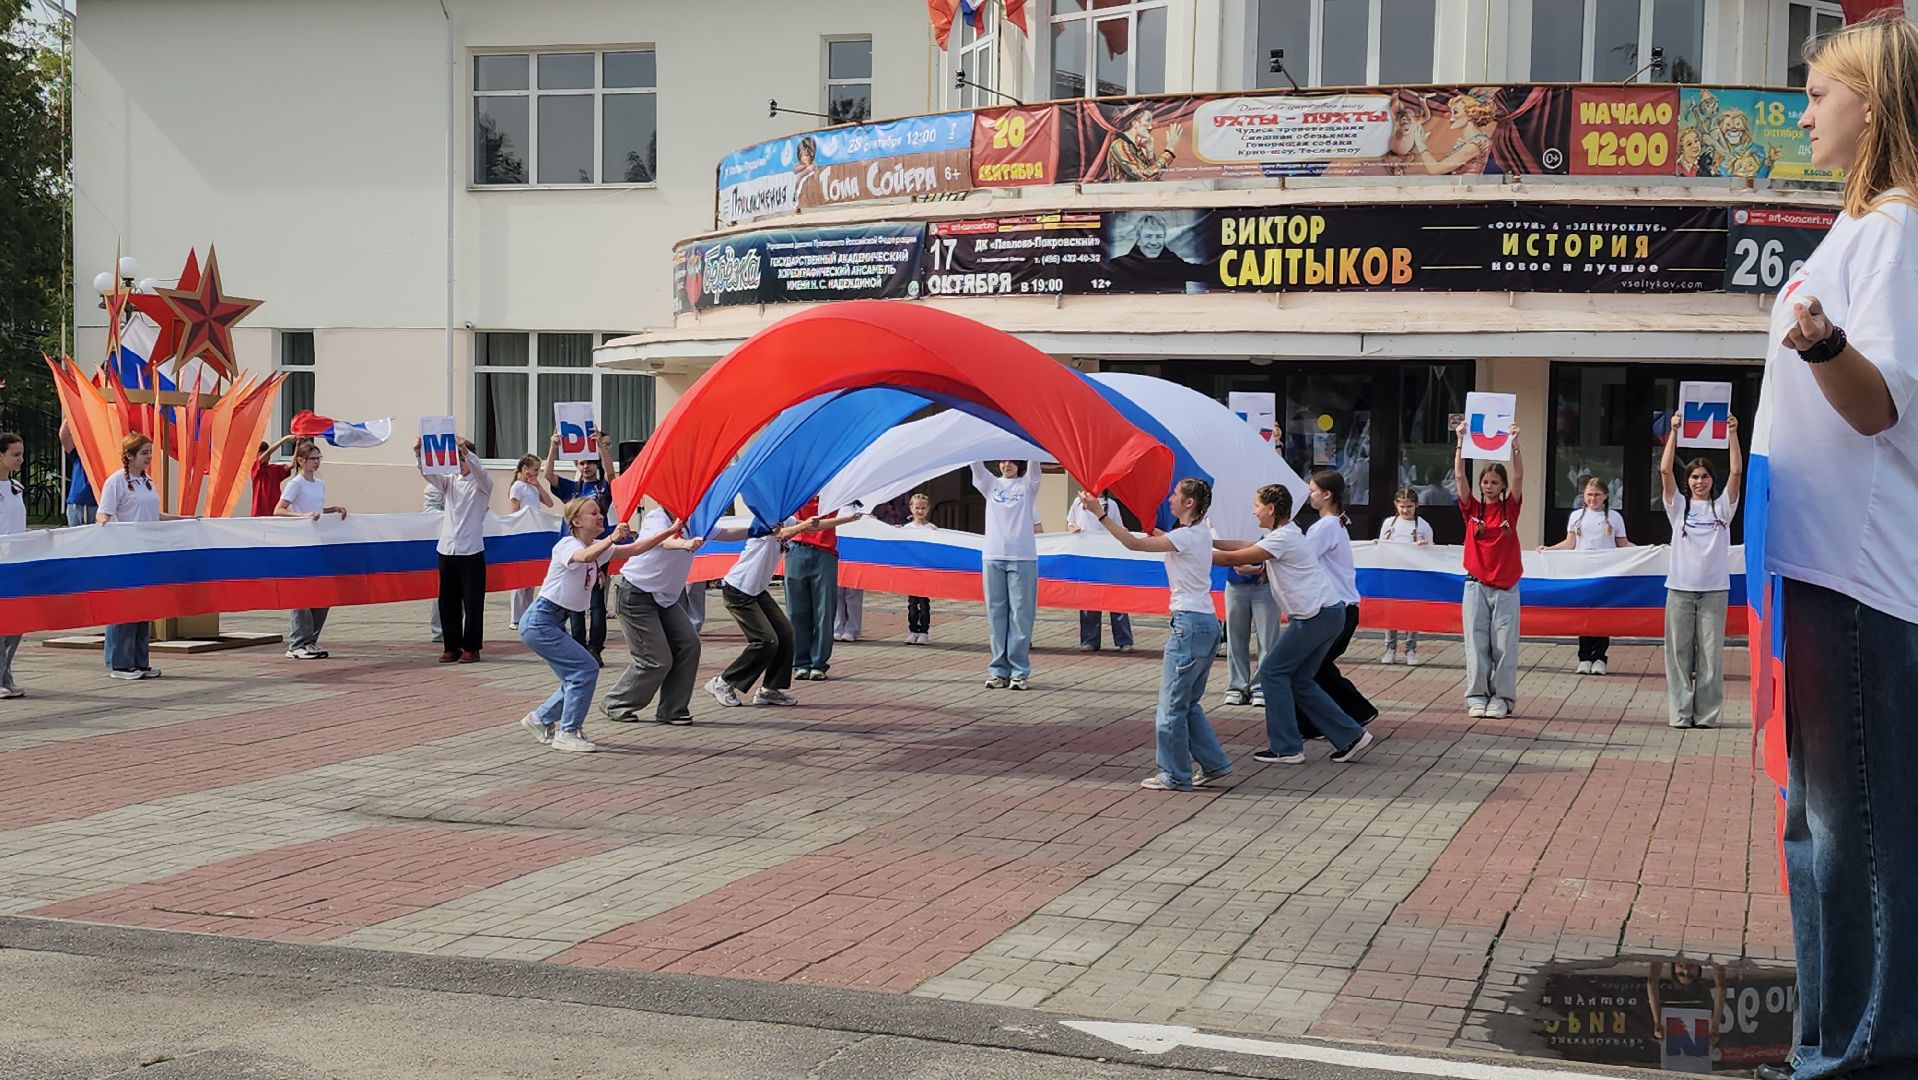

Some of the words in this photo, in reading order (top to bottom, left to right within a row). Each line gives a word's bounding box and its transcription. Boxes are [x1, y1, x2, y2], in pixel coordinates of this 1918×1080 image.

[1301, 110, 1389, 124] ПУХТЫ
[1580, 102, 1673, 125] НАЧАЛО
[1754, 100, 1786, 127] 18
[847, 135, 863, 154] 28
[906, 128, 936, 146] 12:00
[993, 116, 1026, 149] 20
[1236, 127, 1274, 135] Чудеса
[1546, 152, 1561, 165] 0+
[1581, 131, 1669, 167] 12:00
[944, 166, 962, 181] 6+
[978, 160, 1044, 182] СЕНТЯБРЯ
[1221, 214, 1326, 246] ВИКТОР
[930, 238, 958, 271] 17
[975, 239, 988, 253] ДК
[1502, 233, 1650, 259] ИСТОРИЯ
[770, 252, 837, 268] ГОСУДАРСТВЕННЫЙ
[838, 248, 909, 264] АКАДЕМИЧЕСКИЙ
[1219, 246, 1413, 287] САЛТЫКОВ
[1491, 261, 1552, 271] новое
[1563, 263, 1572, 272] и
[1584, 263, 1659, 275] лучшее
[1731, 238, 1785, 287] 26
[777, 264, 850, 280] ХОРЕОГРАФИЧЕСКИЙ
[850, 263, 897, 277] АНСАМБЛЬ
[786, 279, 809, 291] ИМЕНИ
[828, 276, 883, 290] НАДЕЖДИНОЙ
[927, 272, 1013, 295] ОКТЯБРЯ
[1031, 279, 1063, 292] 19:00
[1091, 279, 1112, 289] 12+
